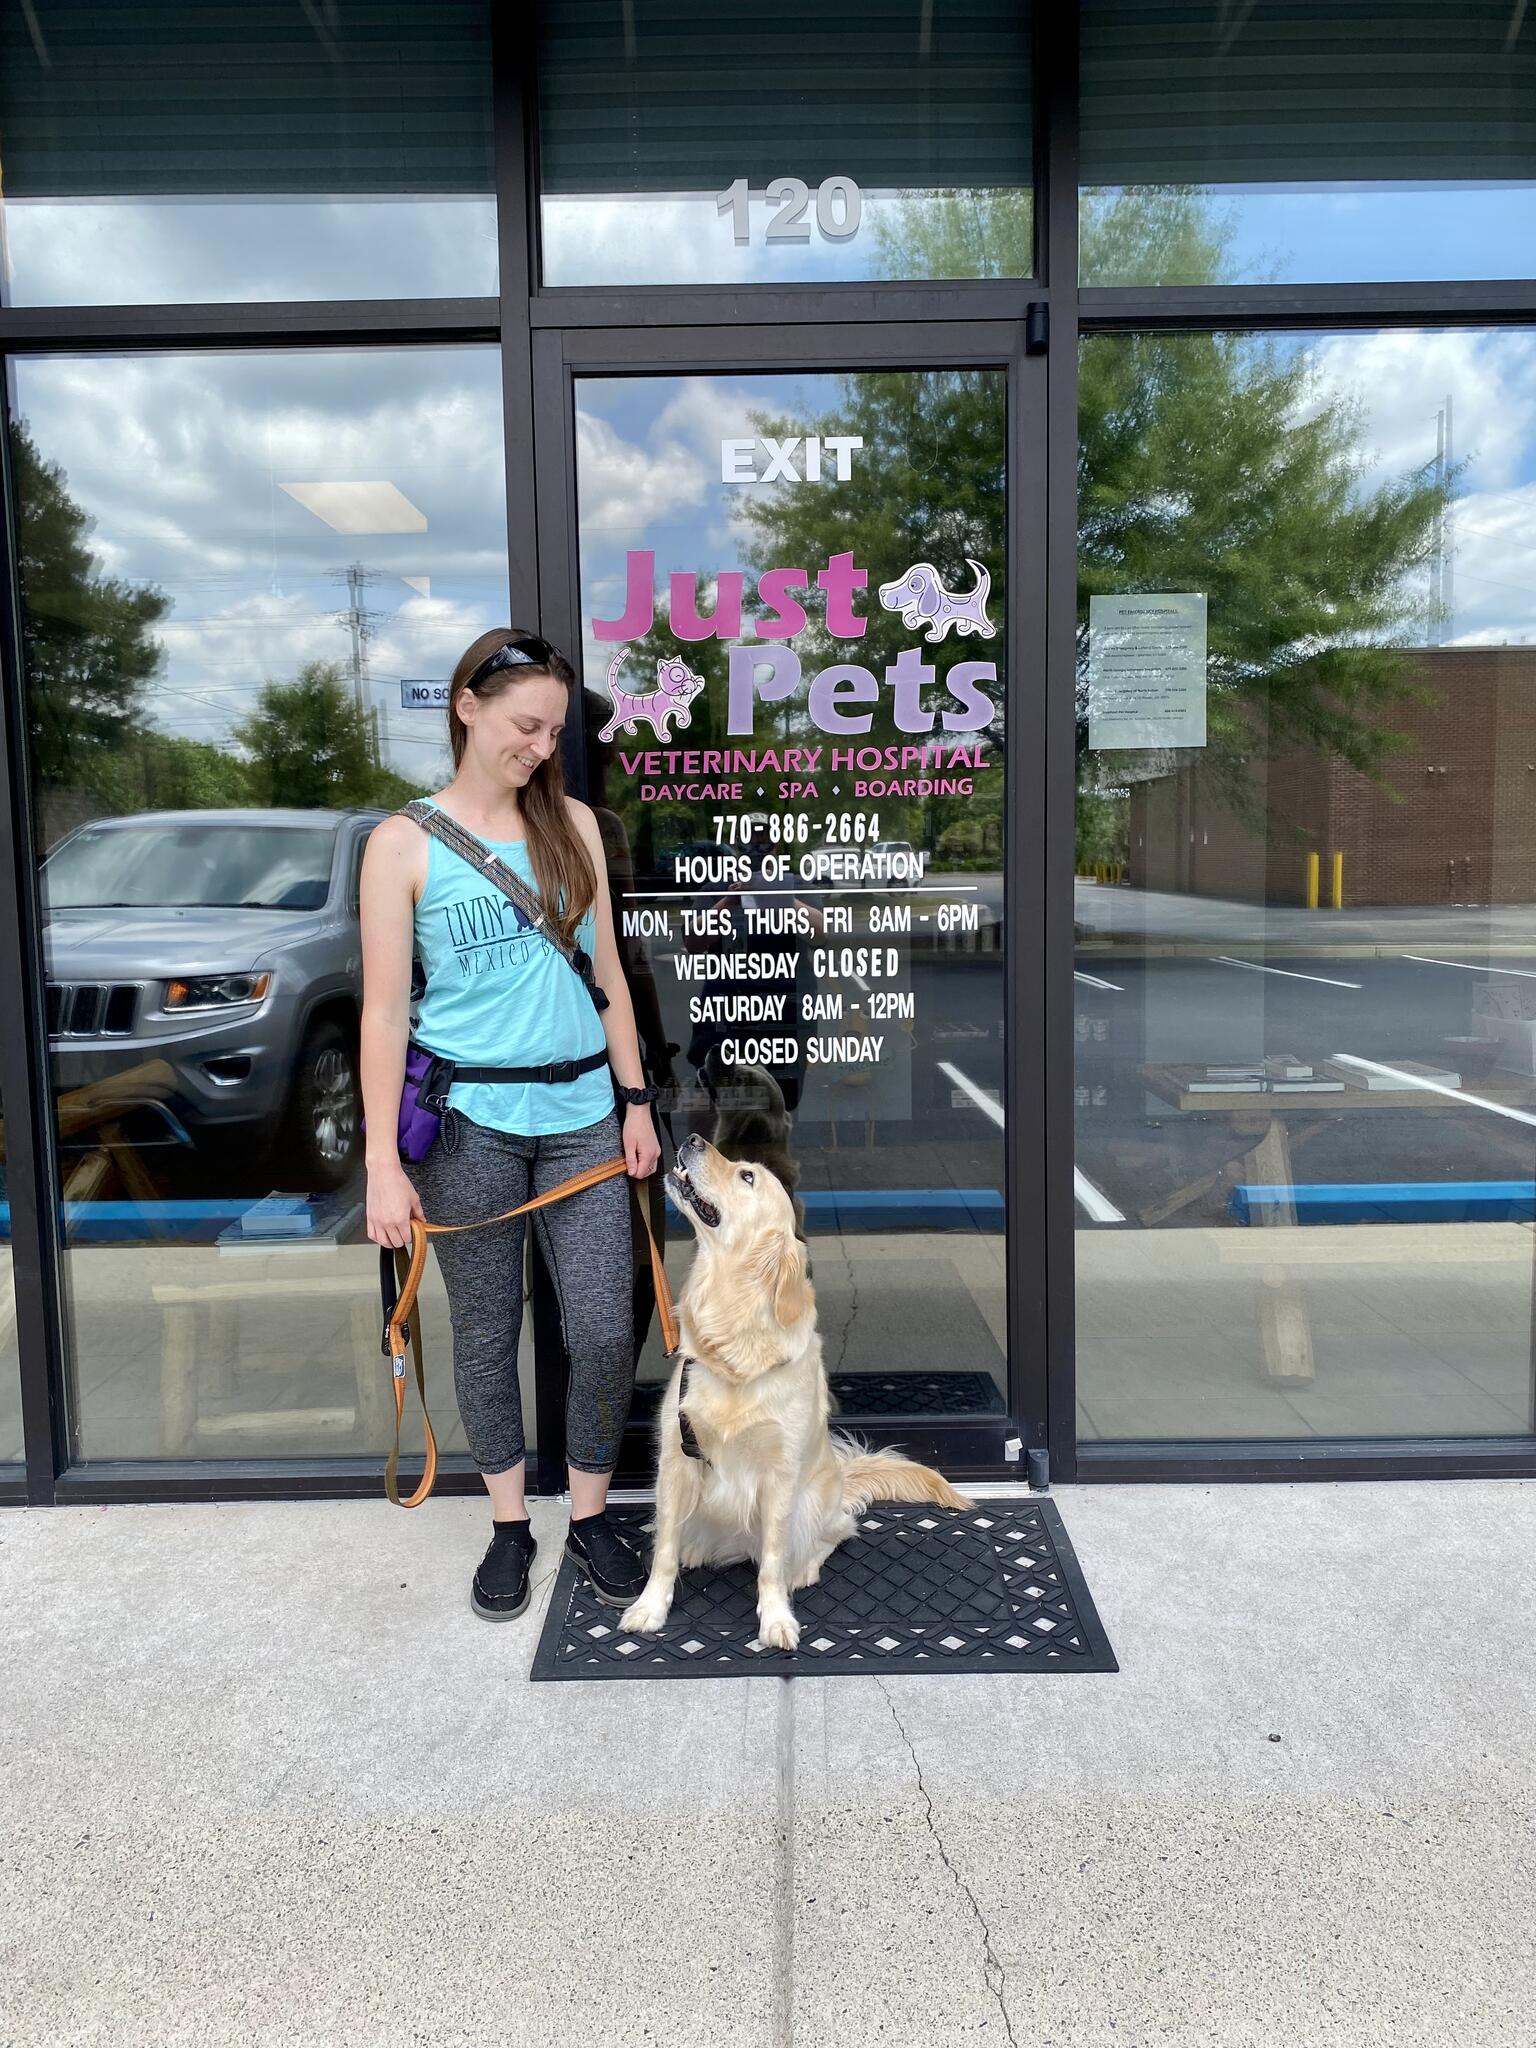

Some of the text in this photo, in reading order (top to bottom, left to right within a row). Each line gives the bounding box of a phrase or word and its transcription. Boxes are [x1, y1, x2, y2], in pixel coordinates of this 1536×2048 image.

[717, 176, 862, 243] 120
[720, 436, 863, 483] EXIT
[591, 550, 869, 642] Just
[412, 688, 430, 700] NO
[726, 644, 999, 736] Pets
[619, 745, 991, 776] VETERINARY HOSPITAL
[640, 777, 975, 801] DAYCARE SPA BOARDING
[713, 812, 881, 845] 770-886-2664
[674, 851, 925, 884] HOURS OF OPERATION
[443, 894, 505, 947] LIVIN
[622, 910, 674, 942] MON,
[680, 908, 738, 941] TUES,
[744, 907, 816, 939] THURS,
[823, 906, 854, 934] FRI
[868, 905, 912, 933] 8AM
[937, 903, 979, 932] 6PM
[458, 941, 530, 977] MEXICO
[673, 947, 899, 981] WEDNESDAY CLOSED
[689, 994, 788, 1023] SATURDAY
[802, 993, 843, 1021] 8AM
[867, 992, 915, 1019] 12PM
[720, 1036, 885, 1066] CLOSED SUNDAY
